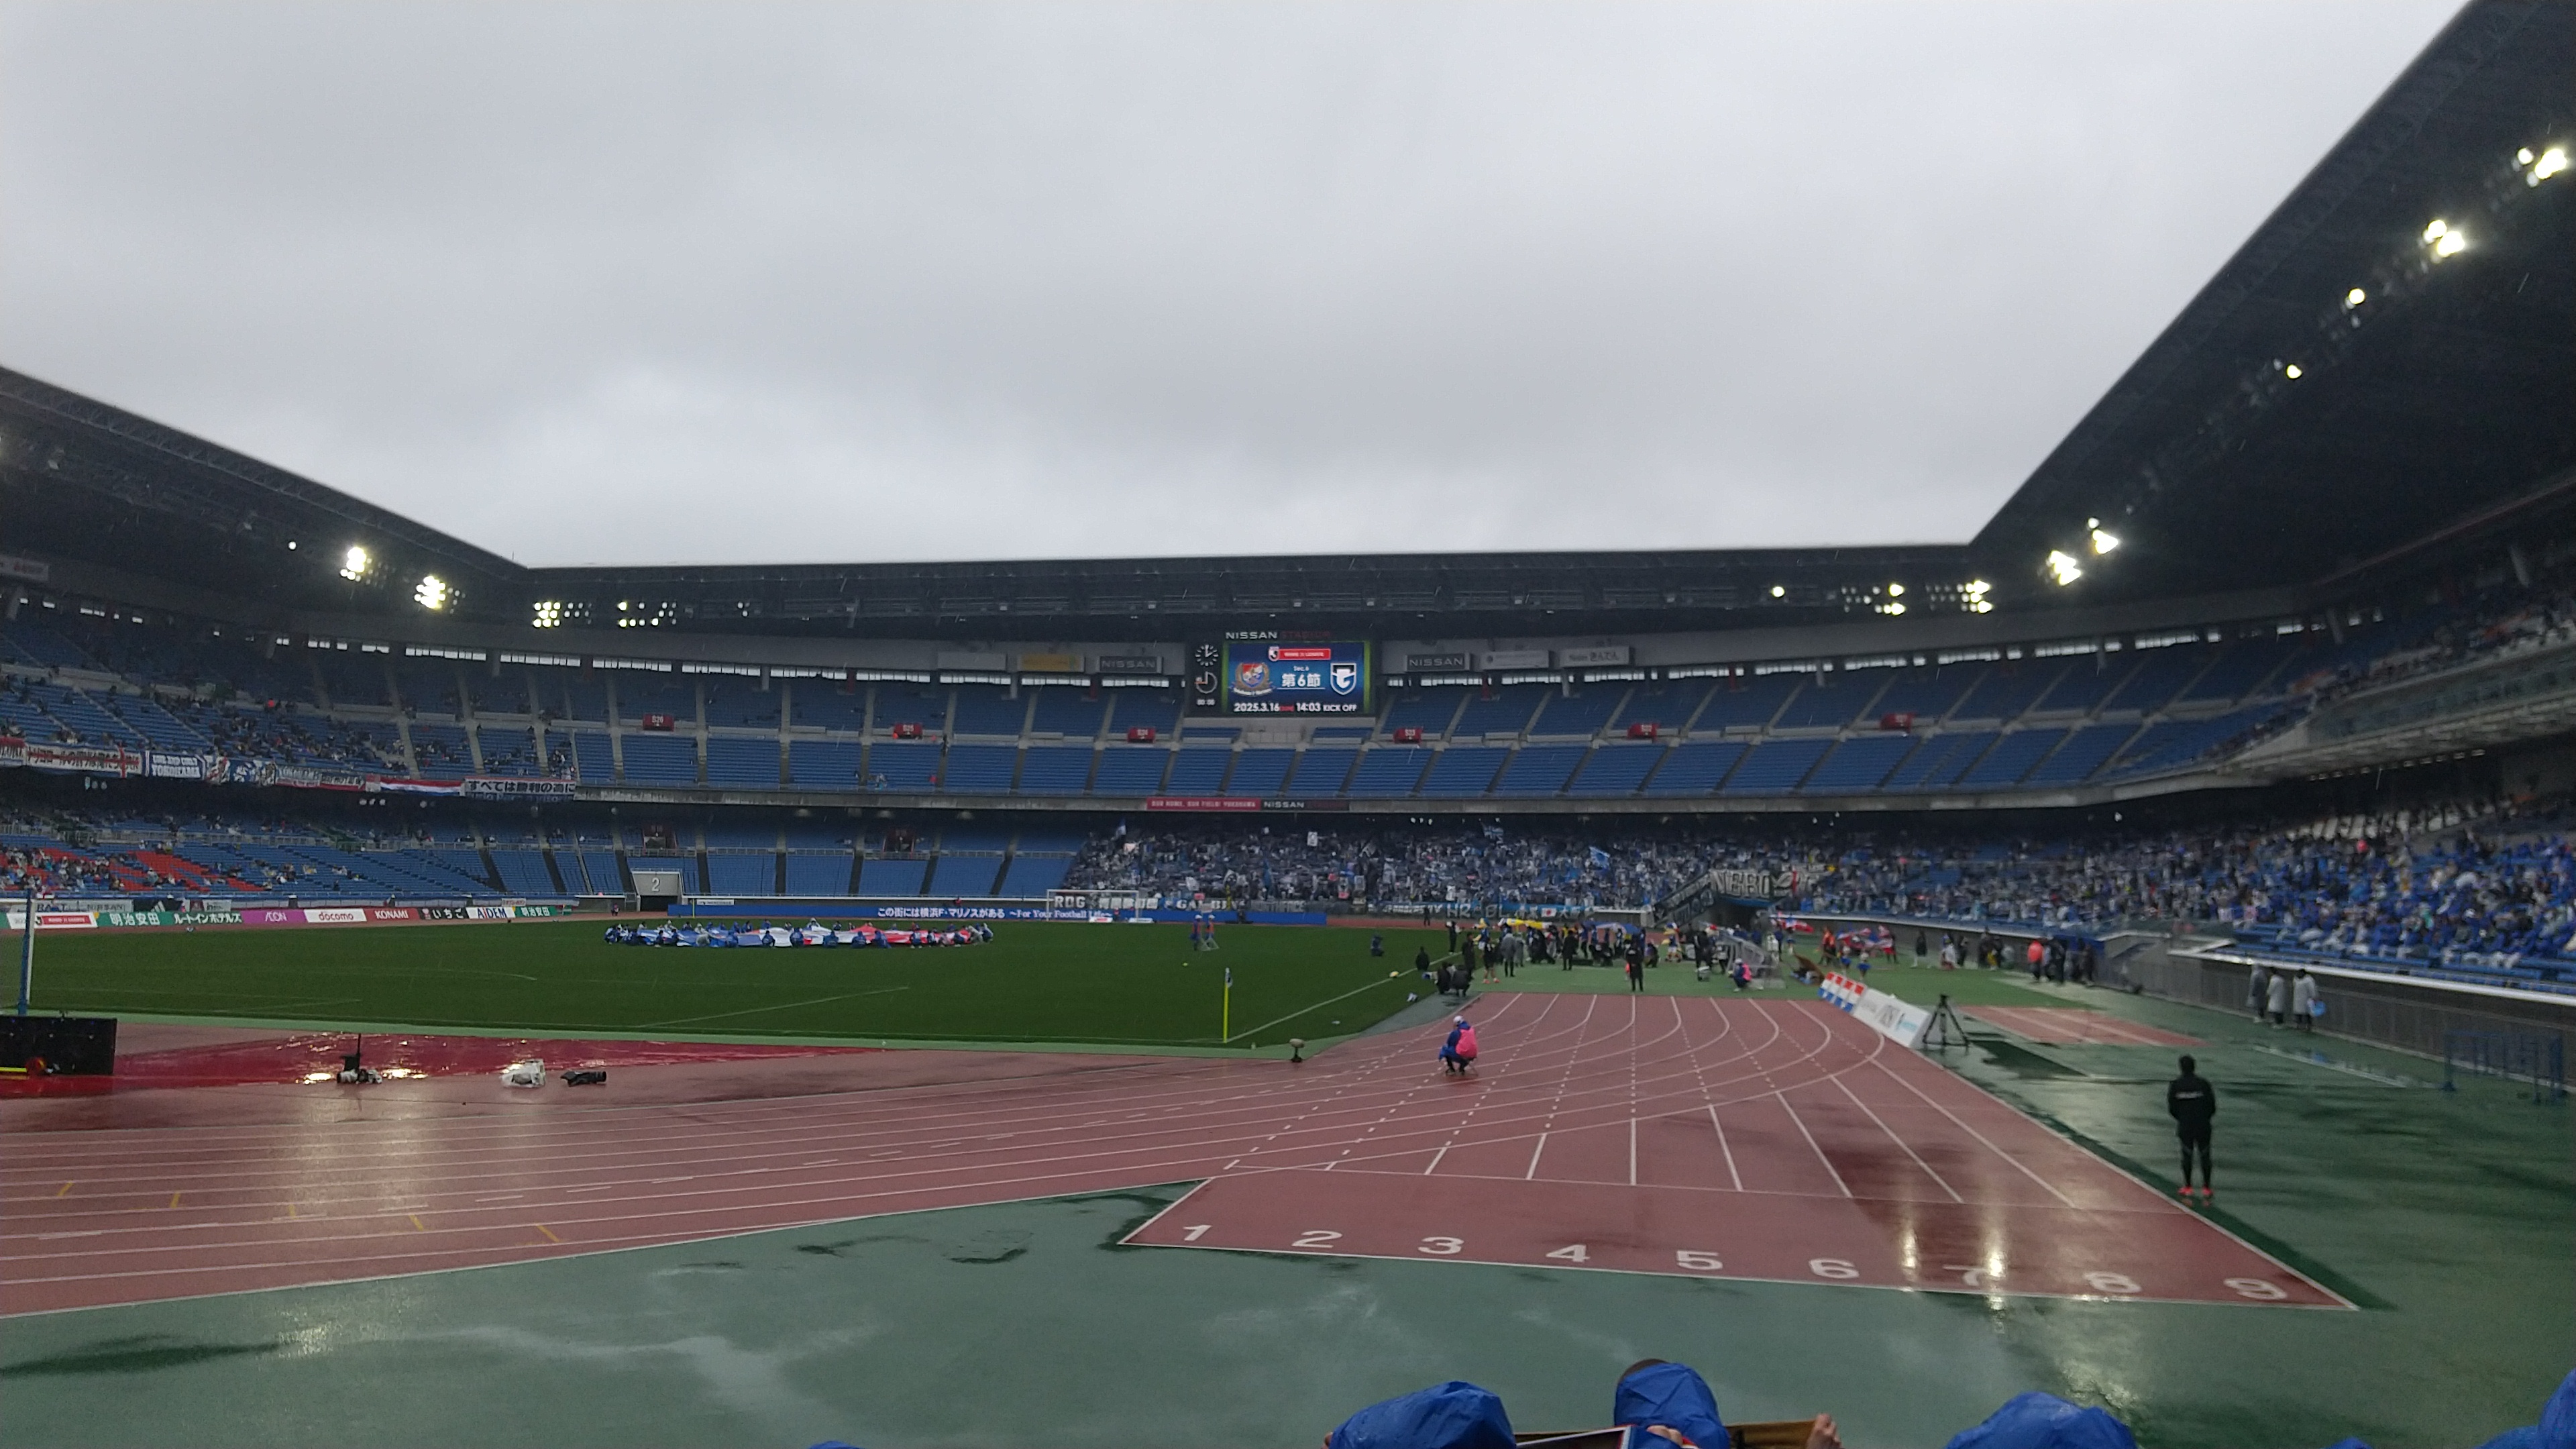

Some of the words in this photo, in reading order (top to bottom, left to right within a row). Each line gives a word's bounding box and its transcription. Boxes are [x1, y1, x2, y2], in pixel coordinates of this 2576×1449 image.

[1102, 659, 1155, 669] NISSAN
[1409, 657, 1464, 667] NISSAN
[1281, 673, 1321, 688] 第6節
[1234, 702, 1280, 712] 2025.3.16
[1296, 702, 1321, 712] 14:03
[651, 877, 661, 892] 2
[319, 912, 354, 921] docomo
[374, 910, 409, 920] KONAMI
[433, 908, 464, 919] いちご
[521, 907, 550, 917] 明治安田
[1032, 908, 1053, 918] Your
[1055, 909, 1087, 918] Football
[109, 912, 160, 926] 明治安田
[174, 912, 243, 924] ルートインホテルズ
[1182, 1224, 1212, 1241] 1
[1291, 1230, 1342, 1248] 2
[1417, 1236, 1464, 1255] 3
[1546, 1244, 1591, 1263] 4
[1676, 1250, 1723, 1270] 5
[1807, 1257, 1860, 1279] 6
[2082, 1271, 2143, 1294] 8
[2224, 1277, 2286, 1300] 9
